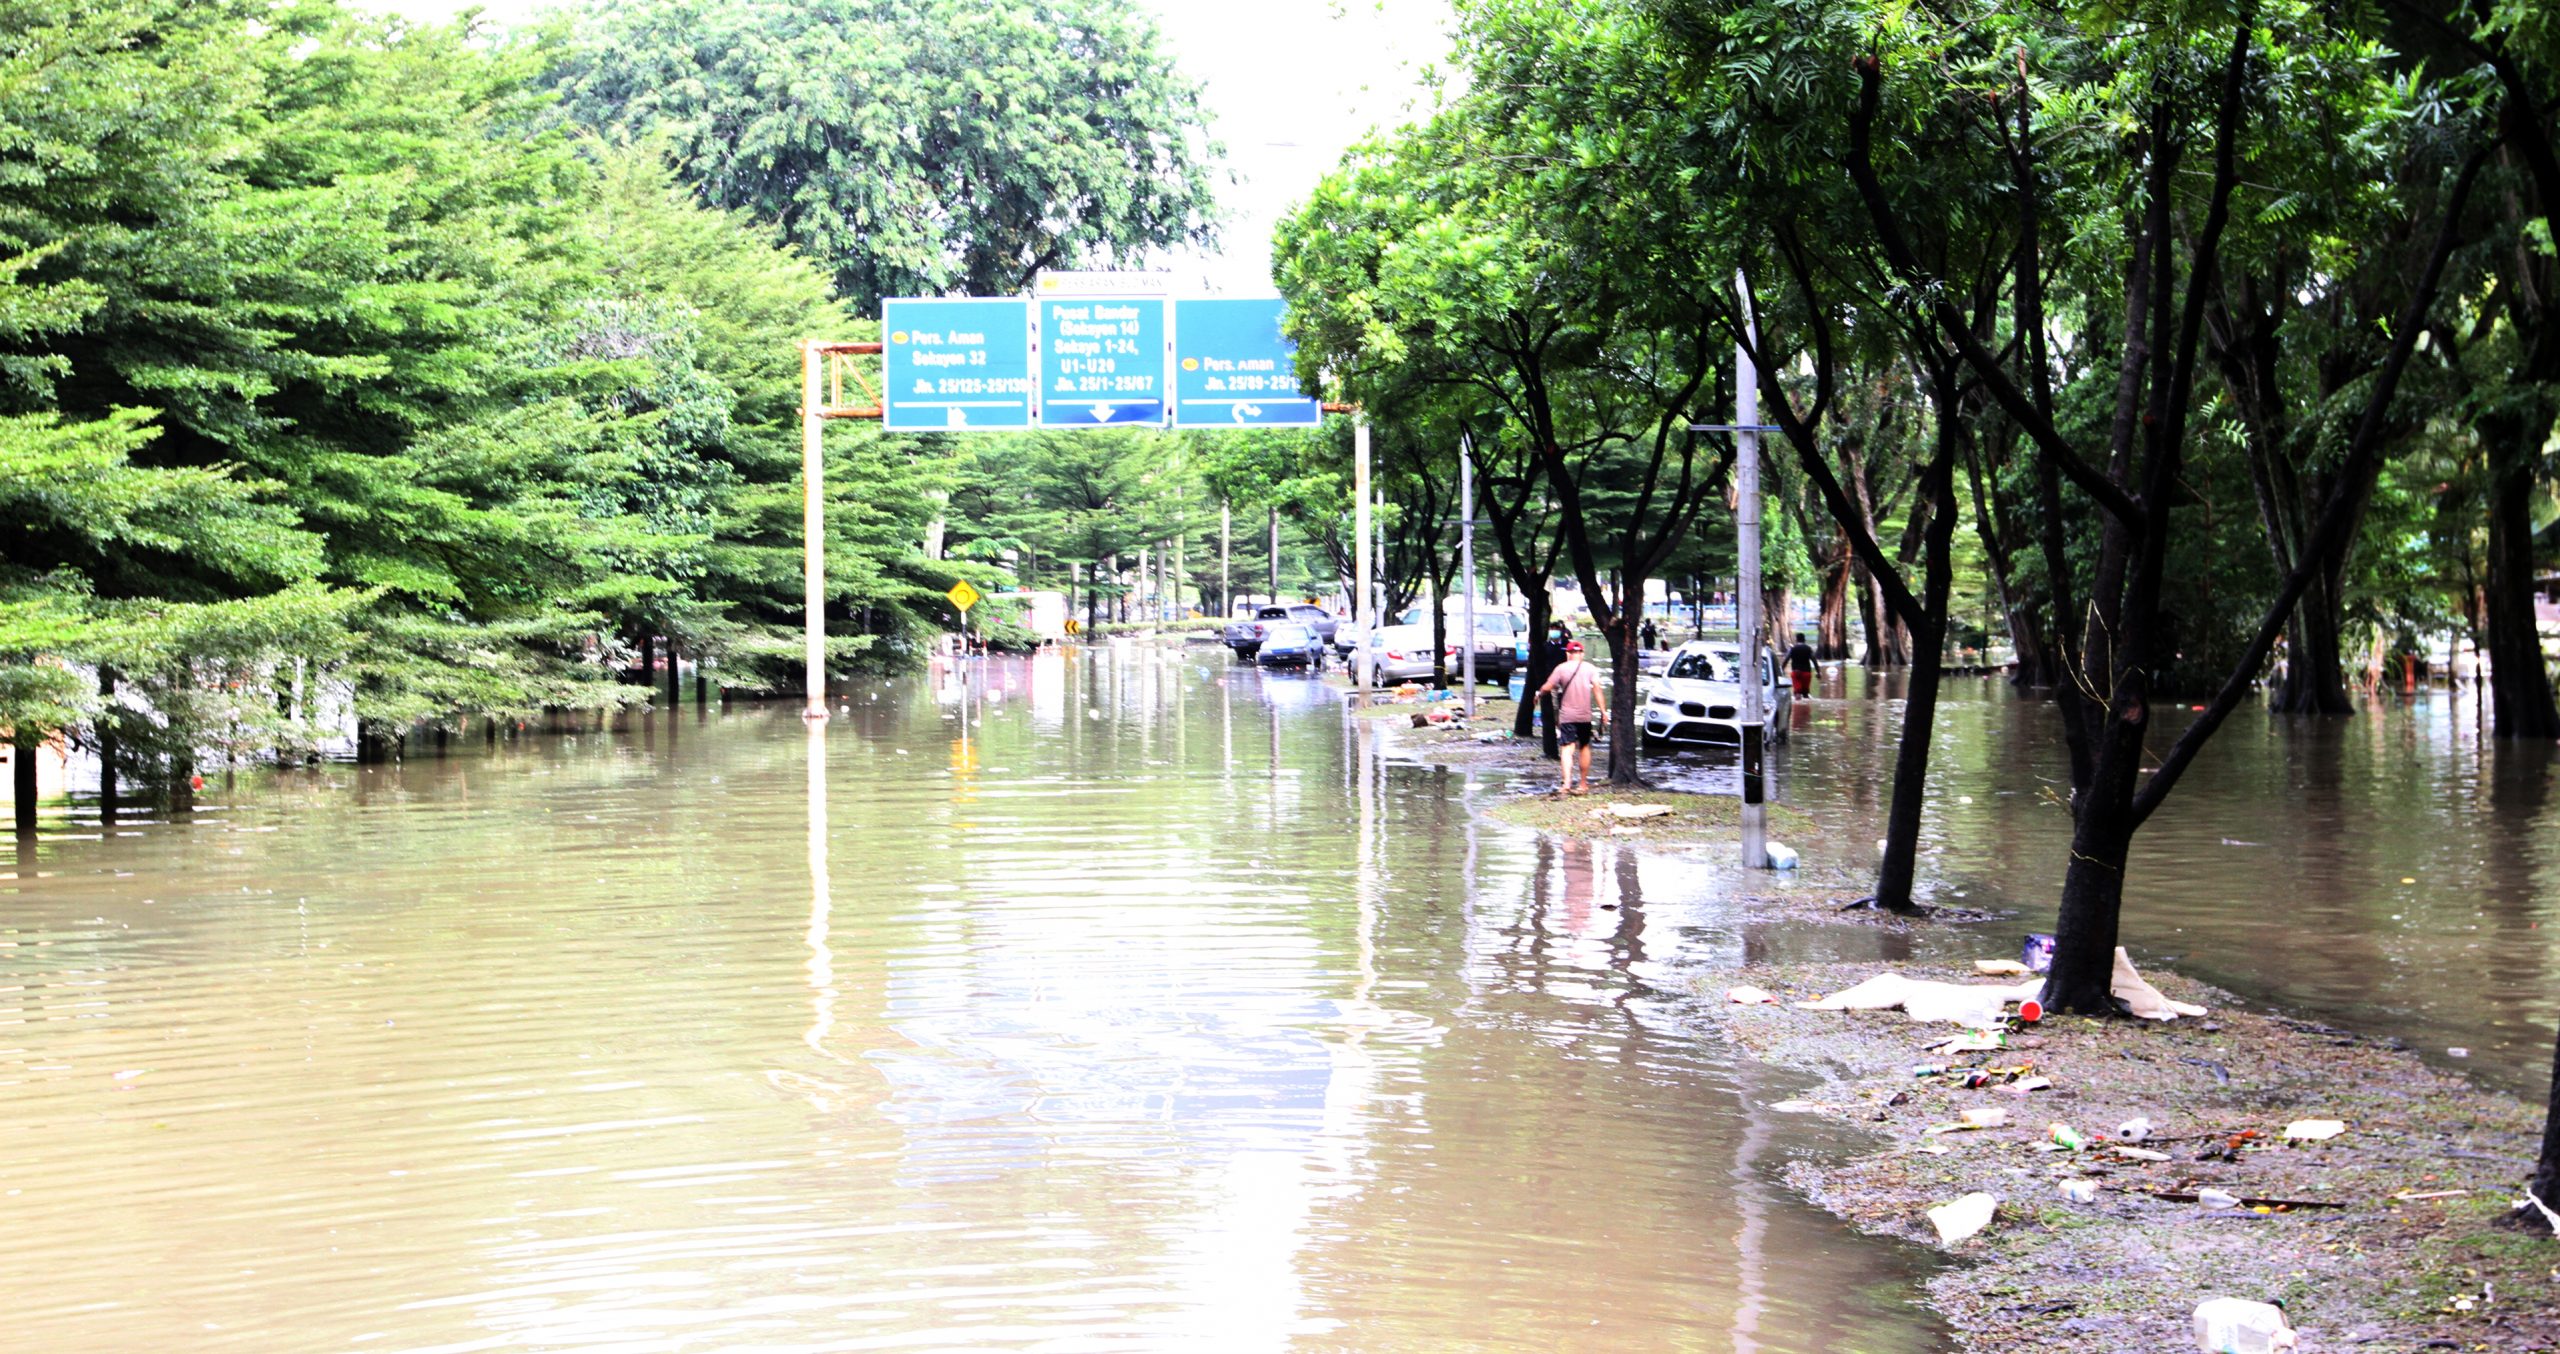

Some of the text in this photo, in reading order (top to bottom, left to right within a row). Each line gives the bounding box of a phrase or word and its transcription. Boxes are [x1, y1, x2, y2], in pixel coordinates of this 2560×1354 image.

[1119, 319, 1140, 336] 14)
[948, 330, 984, 345] Aman
[970, 350, 986, 365] 32
